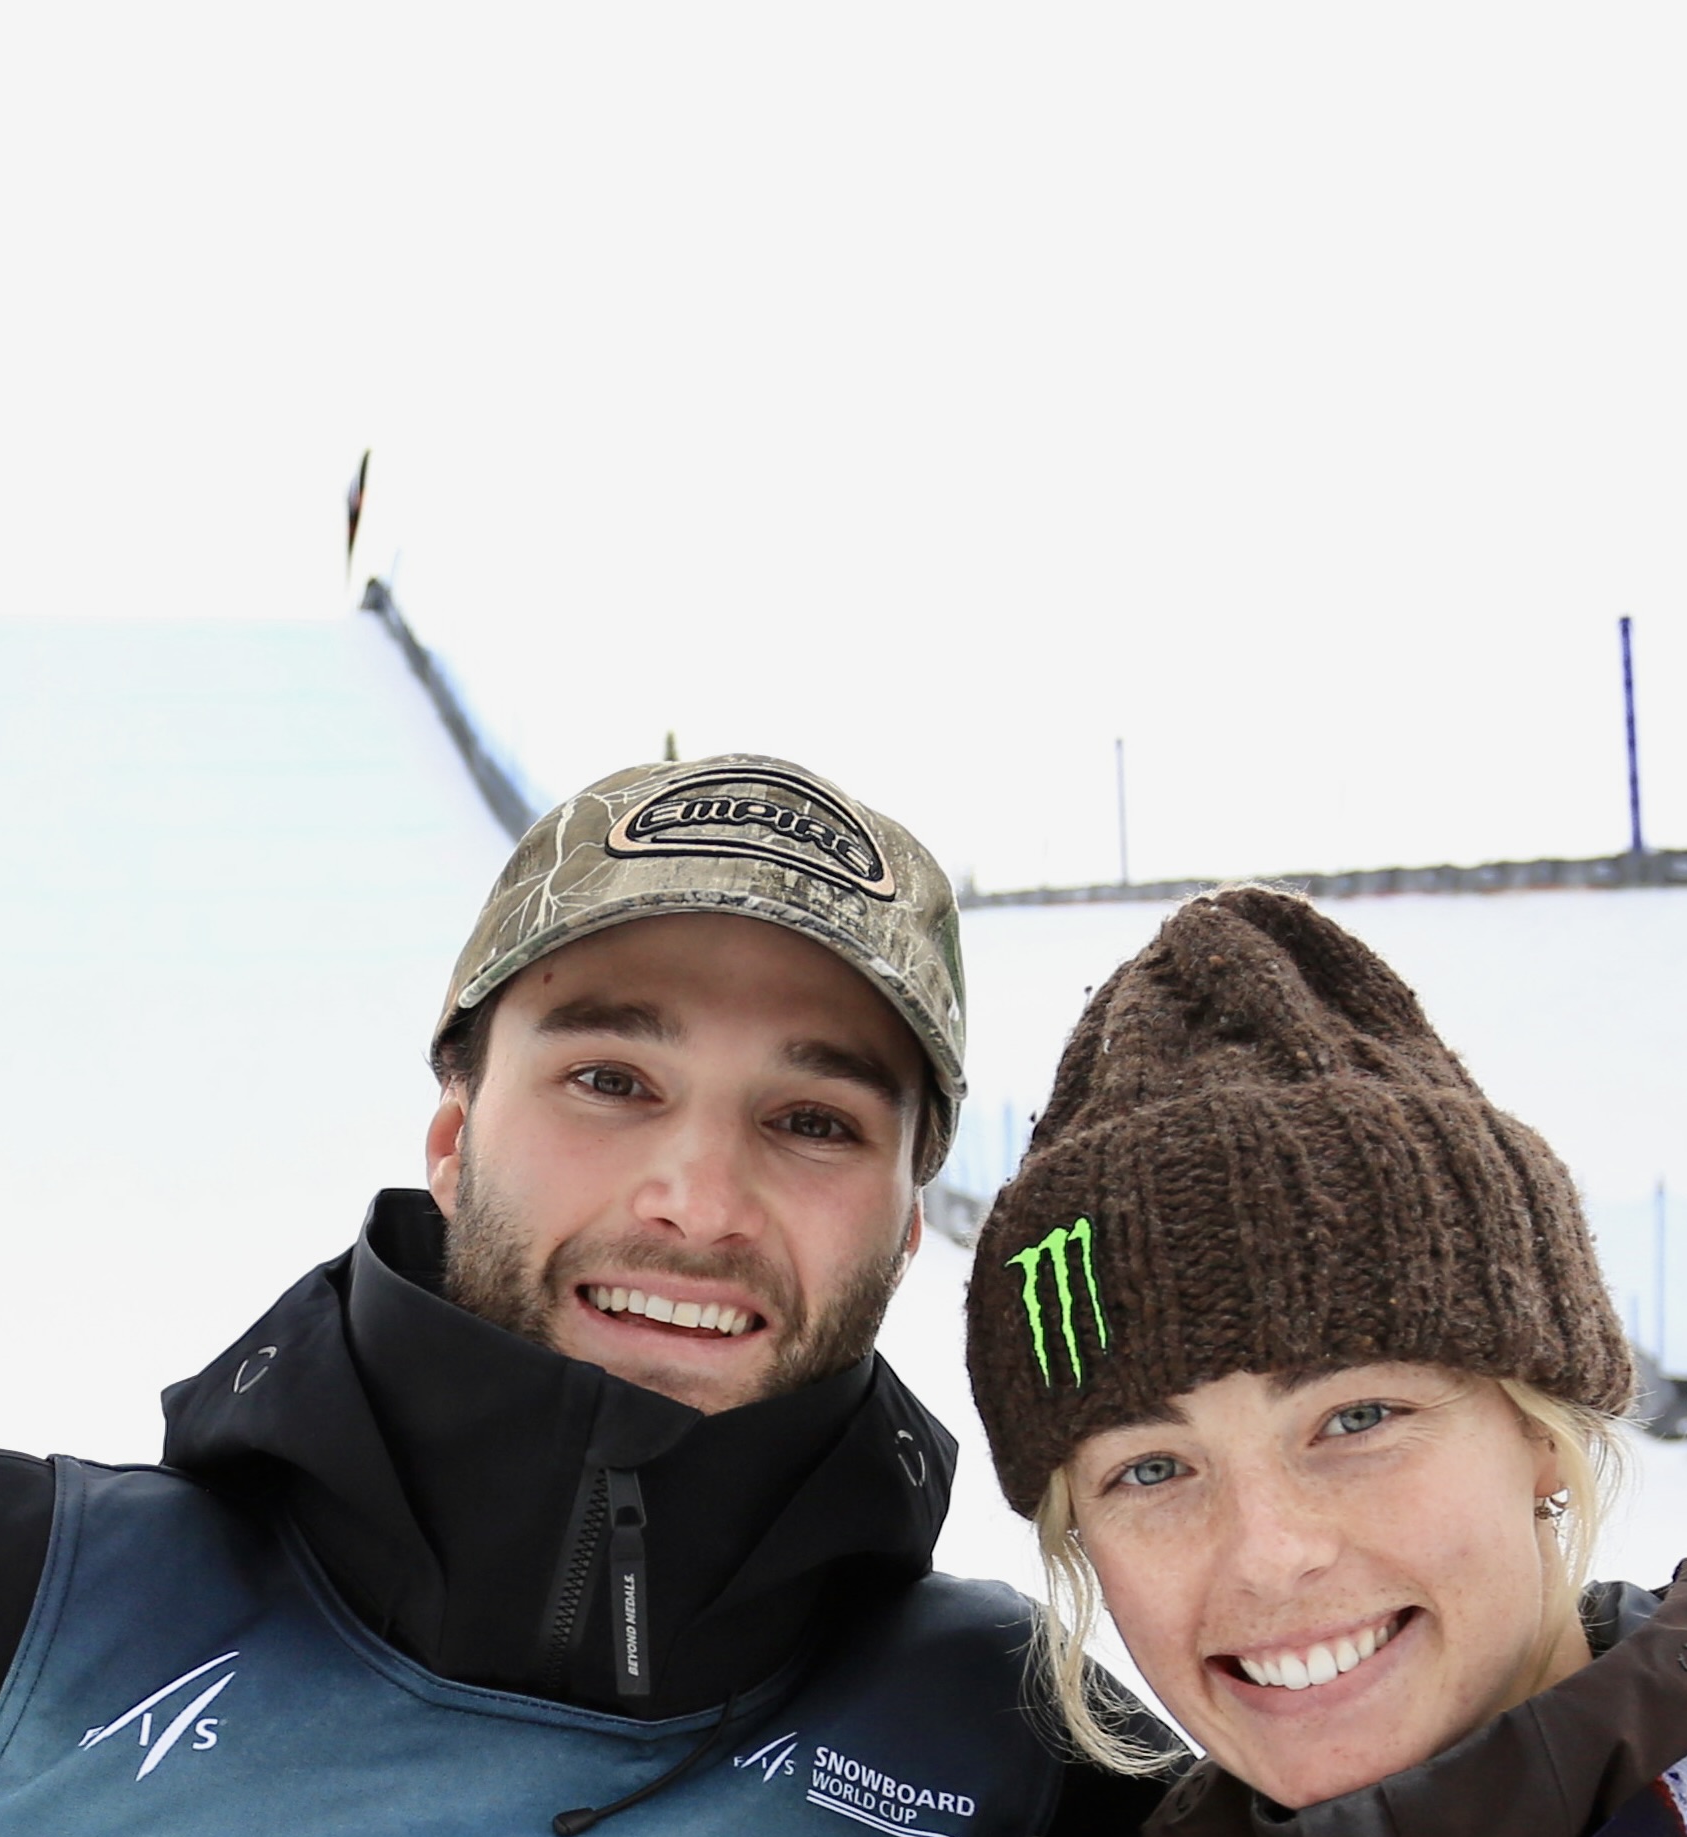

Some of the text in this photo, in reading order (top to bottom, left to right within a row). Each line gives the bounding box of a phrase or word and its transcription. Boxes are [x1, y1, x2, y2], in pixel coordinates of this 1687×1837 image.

[634, 797, 878, 880] EMPIRE
[624, 1573, 639, 1677] BEYOND MEDALS.
[812, 1768, 917, 1825] WORLD CUP
[814, 1746, 975, 1817] SNOWBOARD
